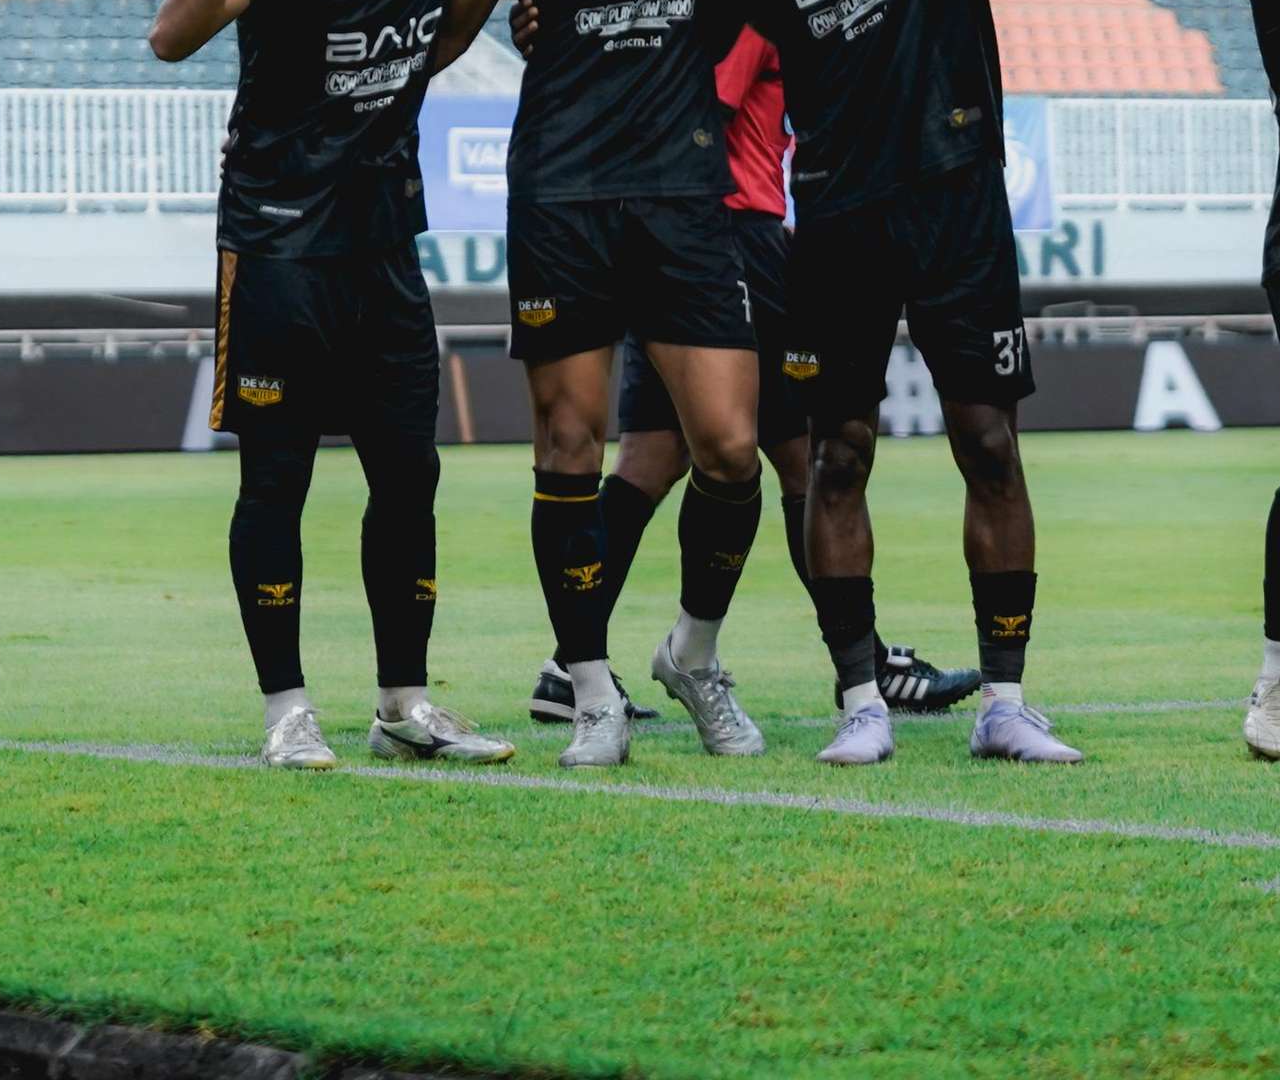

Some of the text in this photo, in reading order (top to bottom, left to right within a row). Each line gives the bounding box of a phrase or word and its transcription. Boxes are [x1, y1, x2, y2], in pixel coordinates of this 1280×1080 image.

[325, 6, 443, 62] BAIC
[518, 299, 552, 310] DEWA
[786, 351, 818, 364] DEWA
[240, 376, 281, 391] DEWA
[257, 597, 296, 606] DRX
